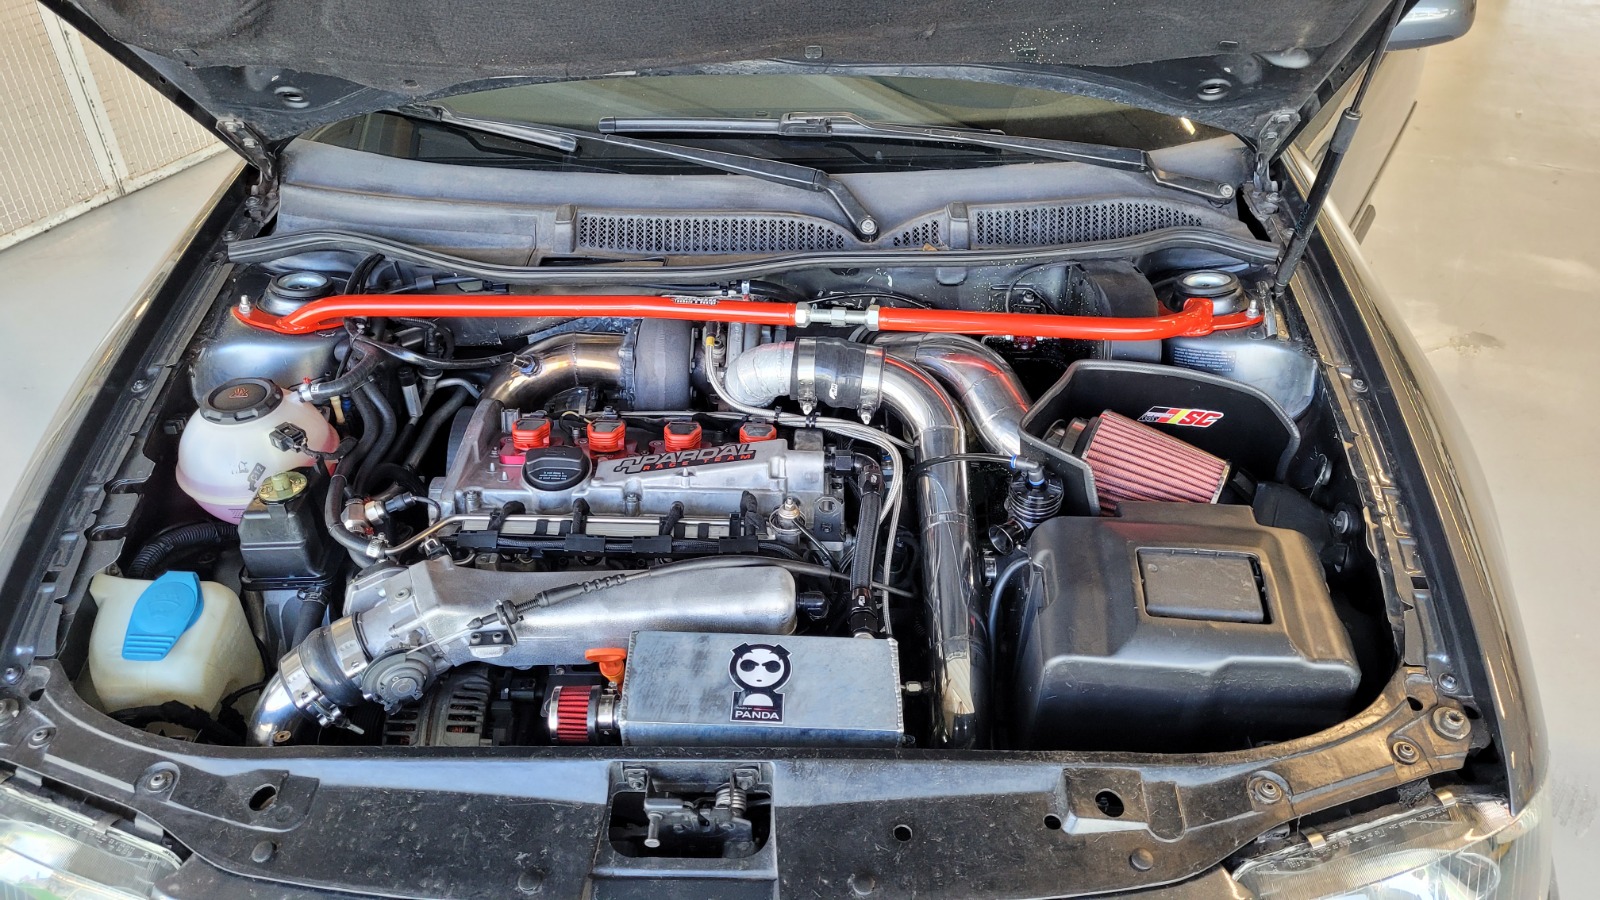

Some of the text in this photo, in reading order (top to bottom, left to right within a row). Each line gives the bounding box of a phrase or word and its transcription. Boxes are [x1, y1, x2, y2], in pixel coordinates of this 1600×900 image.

[641, 443, 755, 466] PARDAL
[642, 454, 751, 471] RACE TEAM
[735, 710, 780, 720] PANDA
